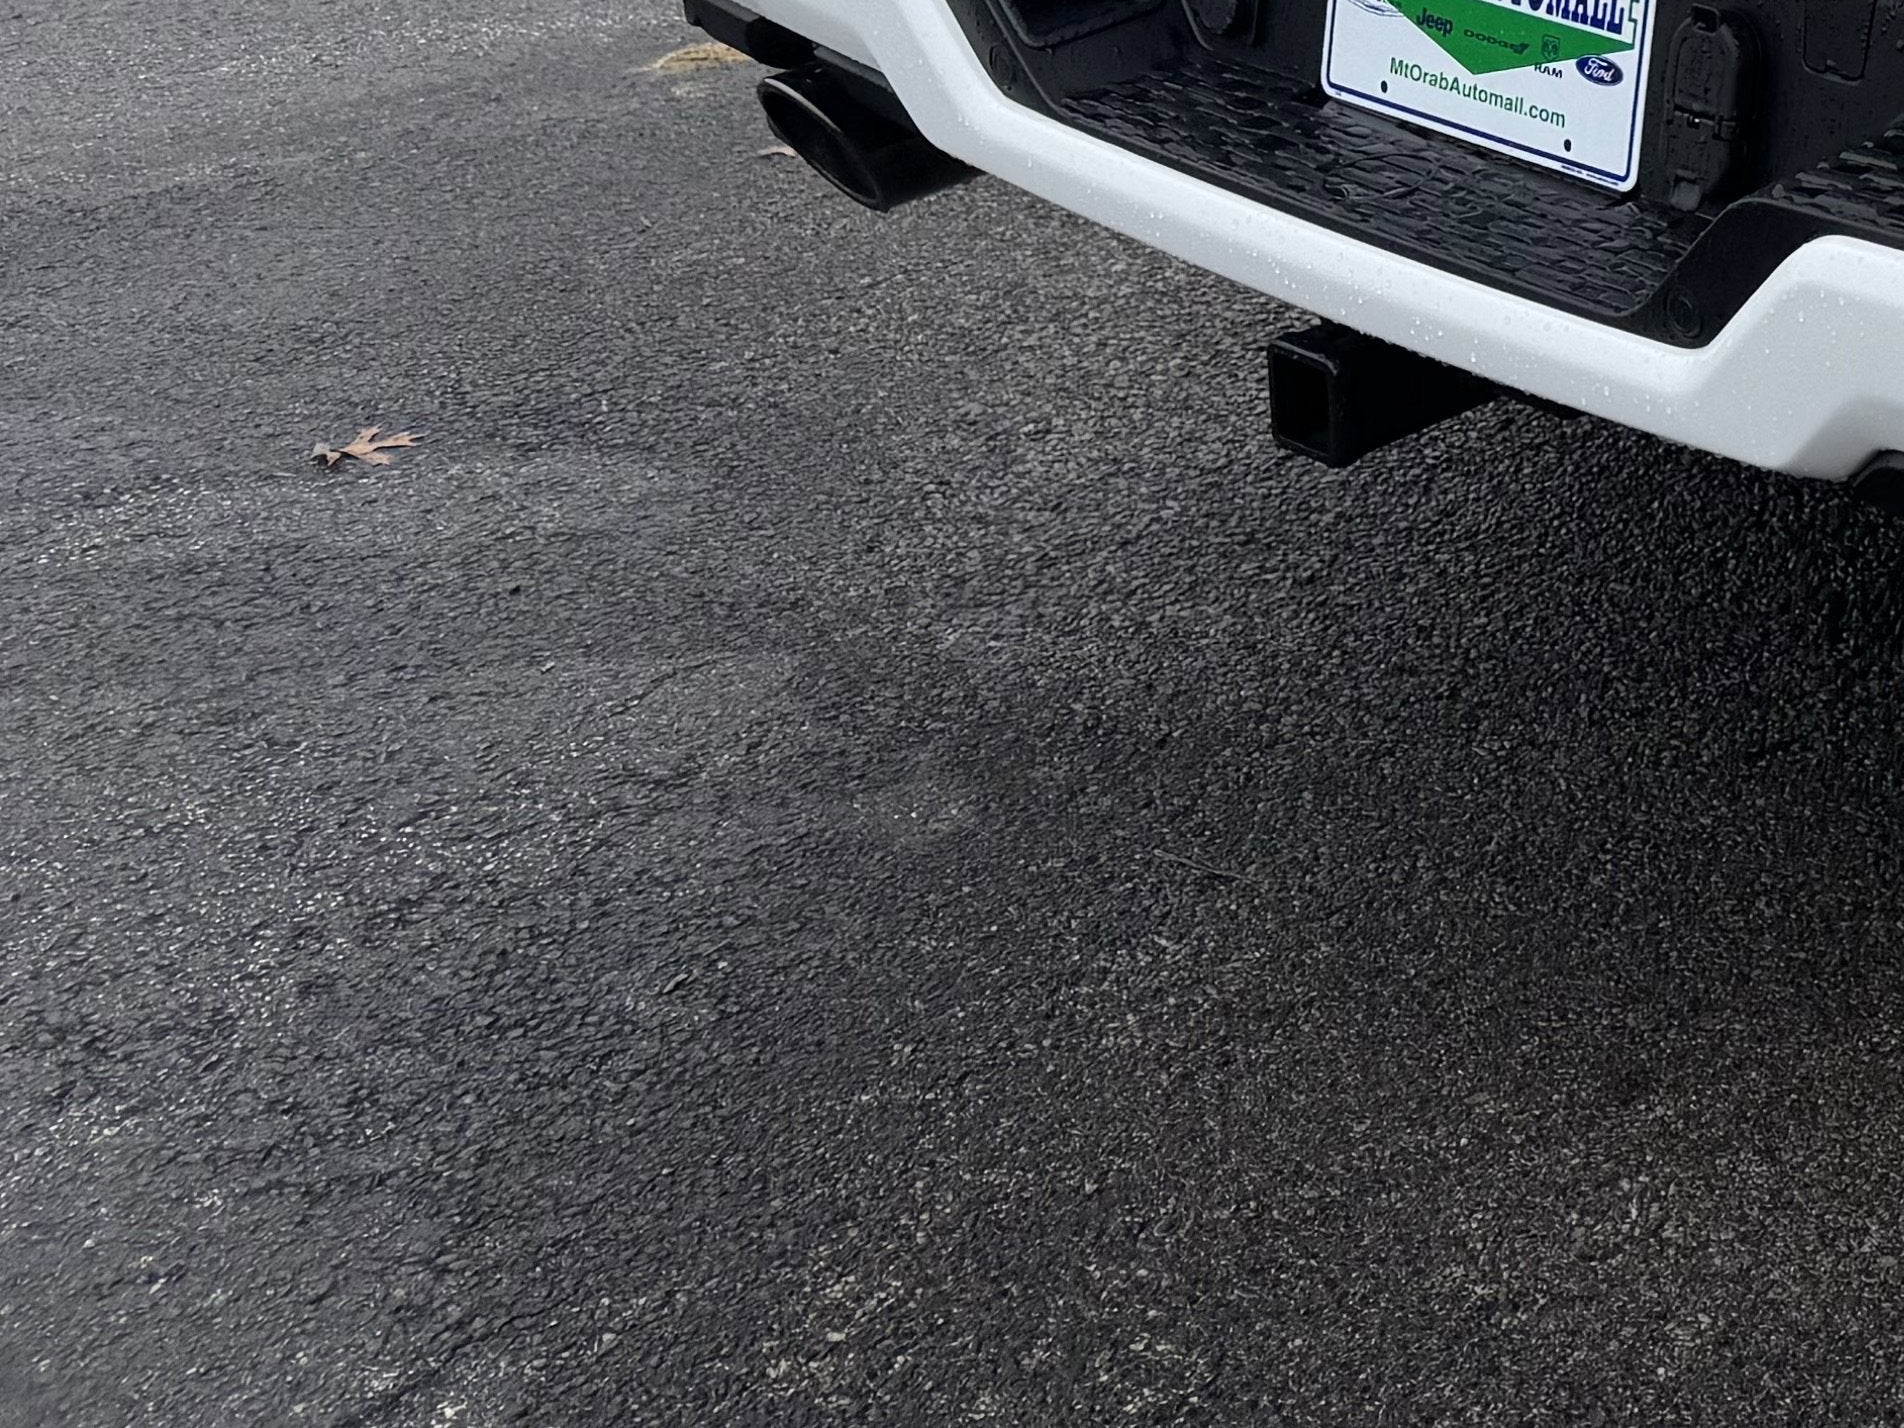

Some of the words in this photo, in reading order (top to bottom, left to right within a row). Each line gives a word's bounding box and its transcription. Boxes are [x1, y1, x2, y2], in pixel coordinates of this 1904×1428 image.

[1415, 7, 1454, 38] Jeep
[1534, 63, 1563, 79] RAM
[1583, 57, 1617, 82] Ford
[1389, 56, 1566, 129] MtOrabAutomall.com
